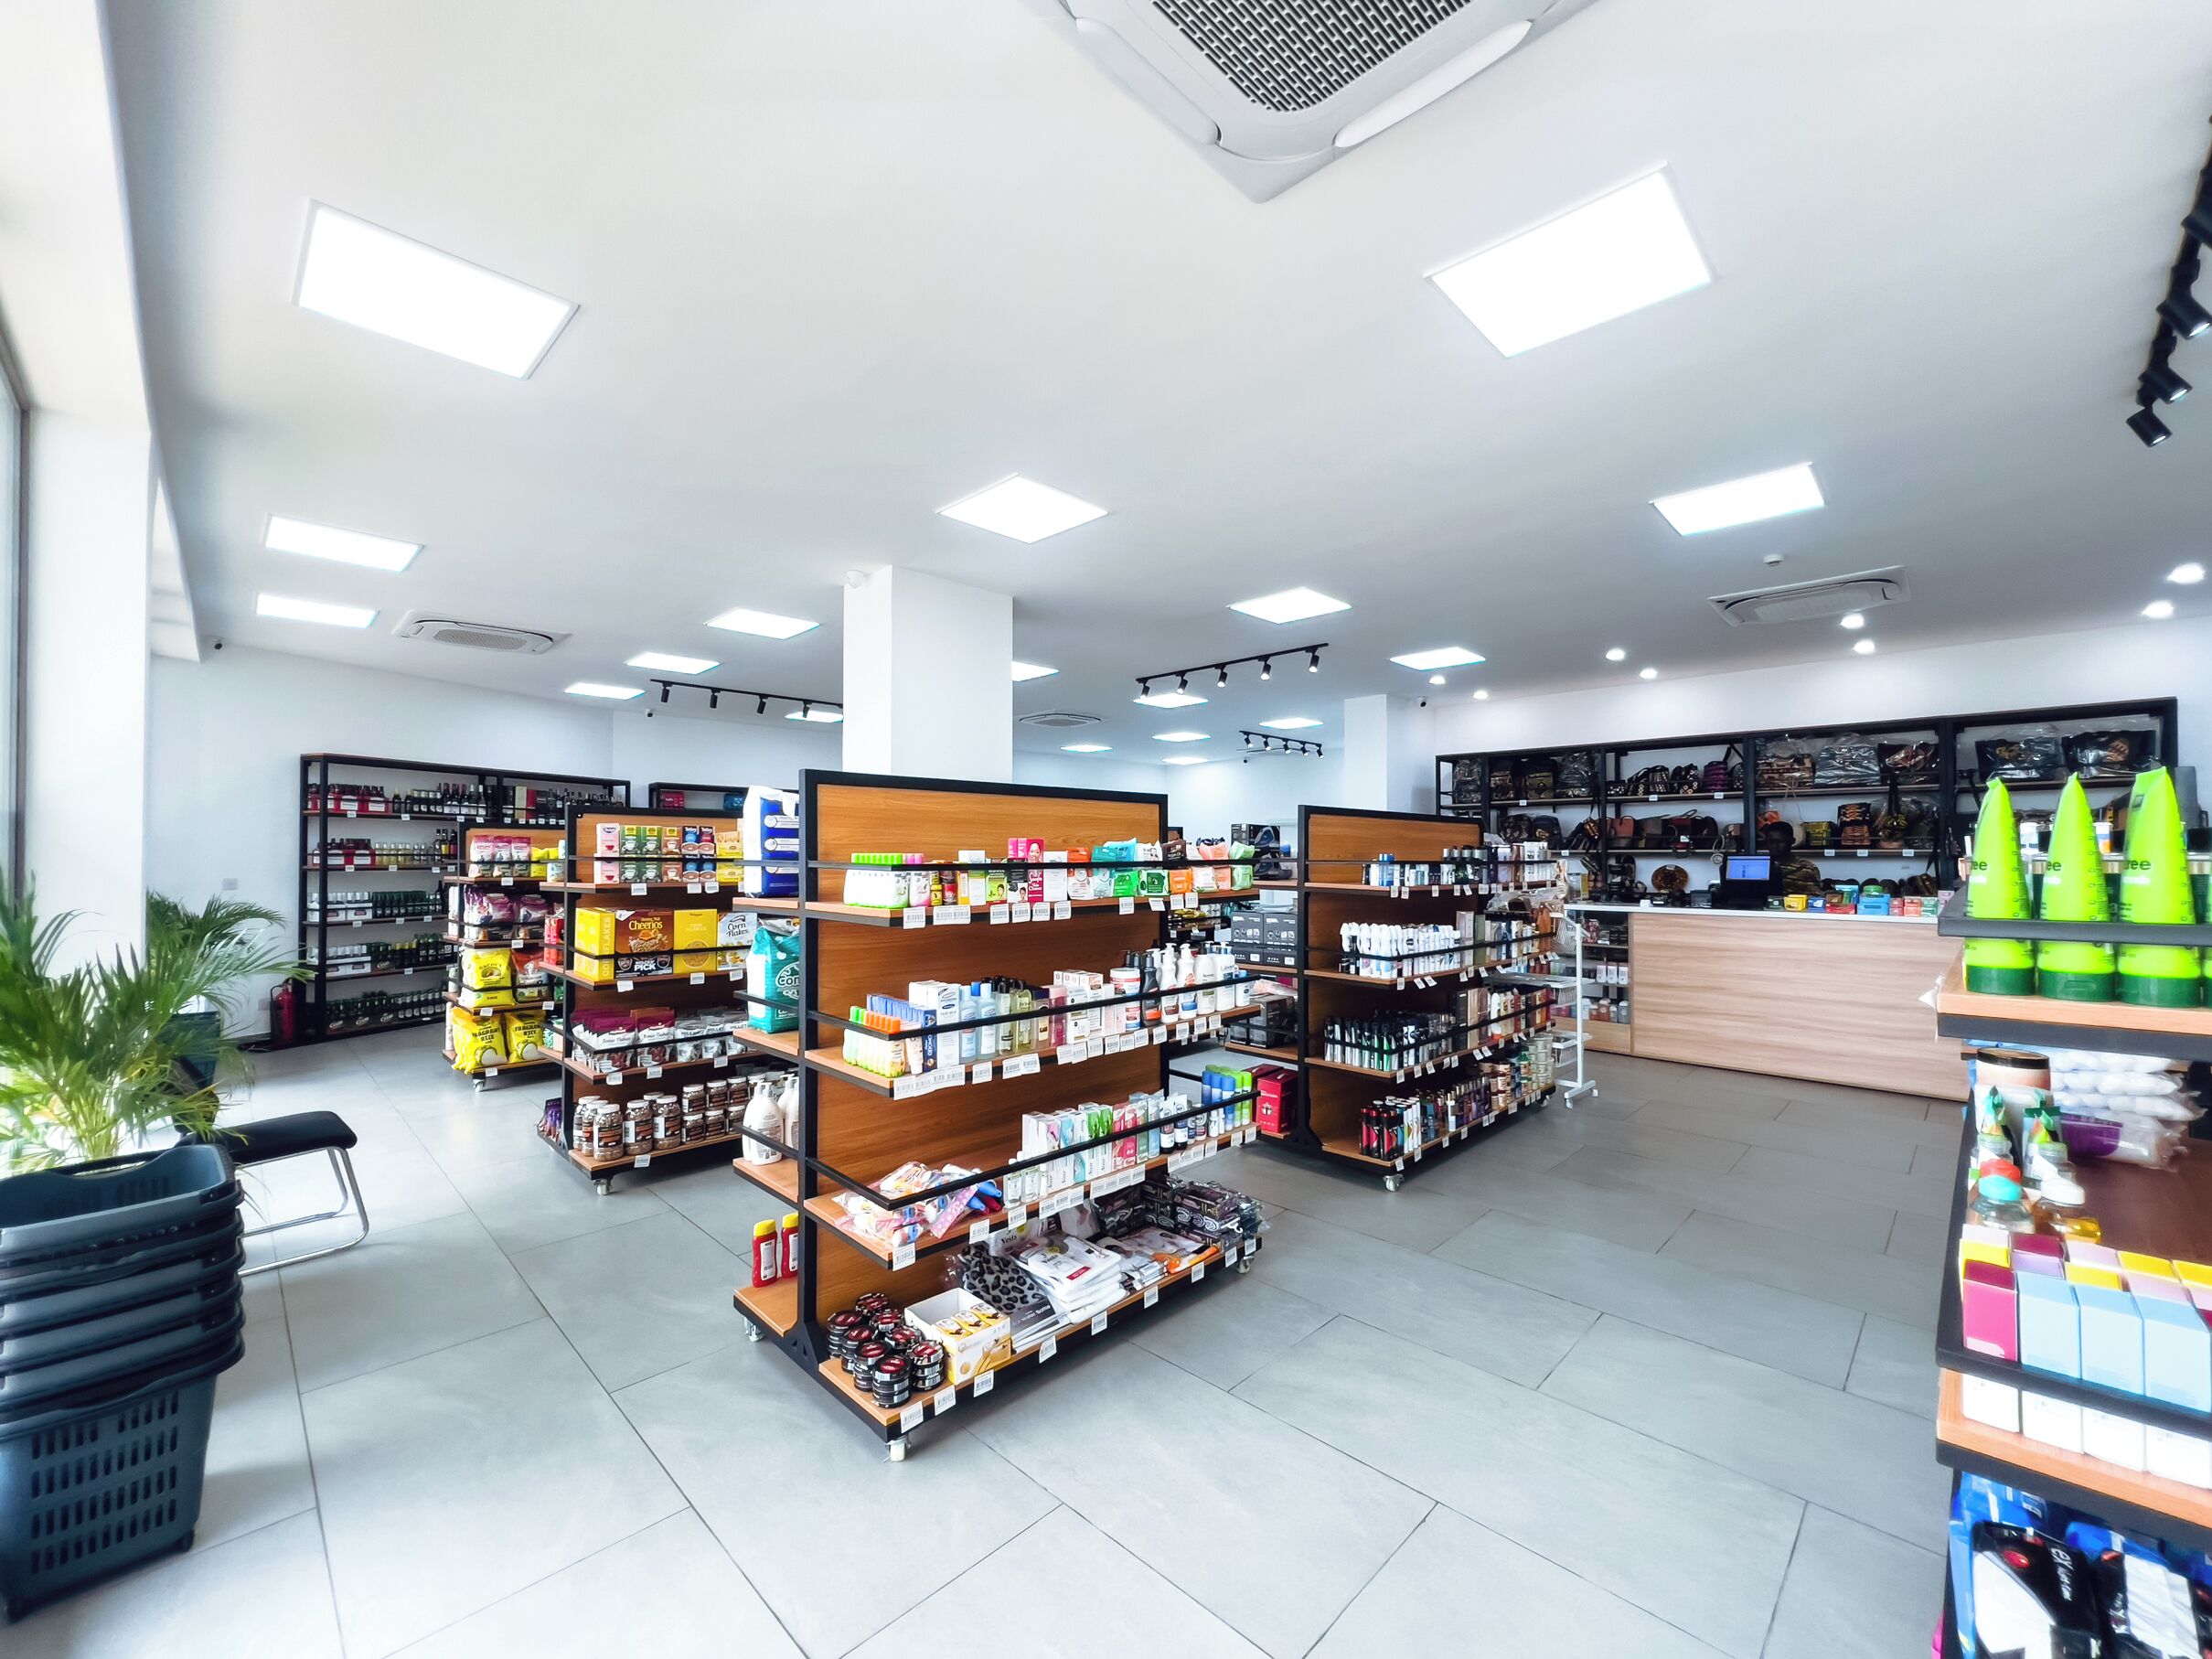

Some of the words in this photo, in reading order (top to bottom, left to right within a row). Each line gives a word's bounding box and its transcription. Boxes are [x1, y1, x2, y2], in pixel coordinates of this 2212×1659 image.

[628, 920, 663, 931] Cheerios
[727, 923, 746, 931] Corn
[603, 916, 611, 952] FLAKES
[726, 928, 749, 937] Flakes
[634, 962, 657, 971] PICK
